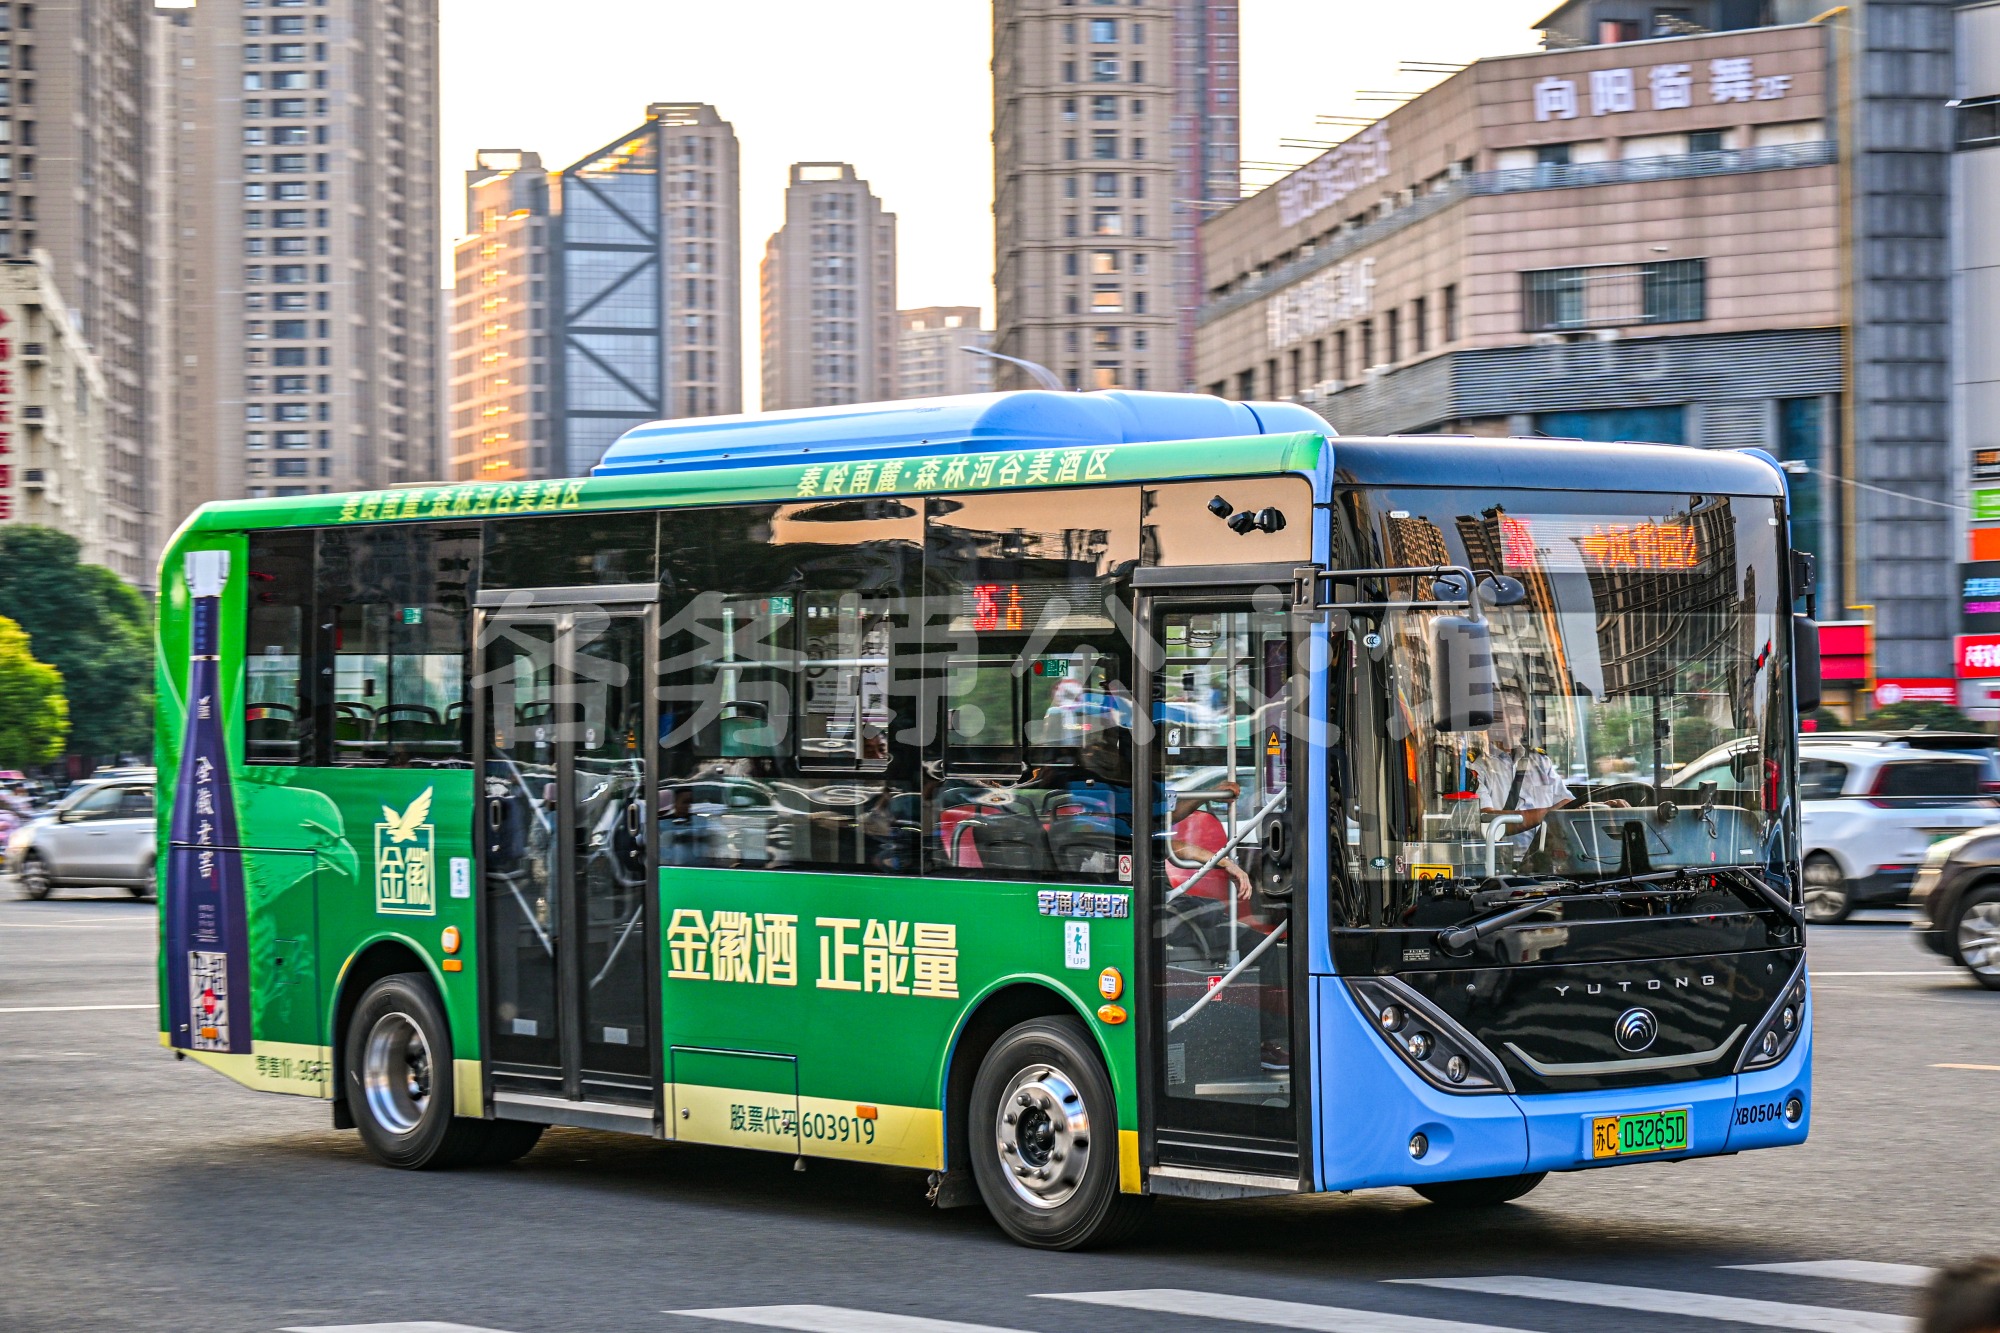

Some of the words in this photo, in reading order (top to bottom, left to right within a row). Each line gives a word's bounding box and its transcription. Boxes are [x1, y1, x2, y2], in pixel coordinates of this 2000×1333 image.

[380, 846, 431, 905] 金徽
[667, 908, 798, 986] 金徽酒
[815, 916, 960, 999] 正能量
[1073, 957, 1086, 965] UP
[1555, 975, 1715, 996] YUTONG
[1735, 1102, 1782, 1126] XB0504
